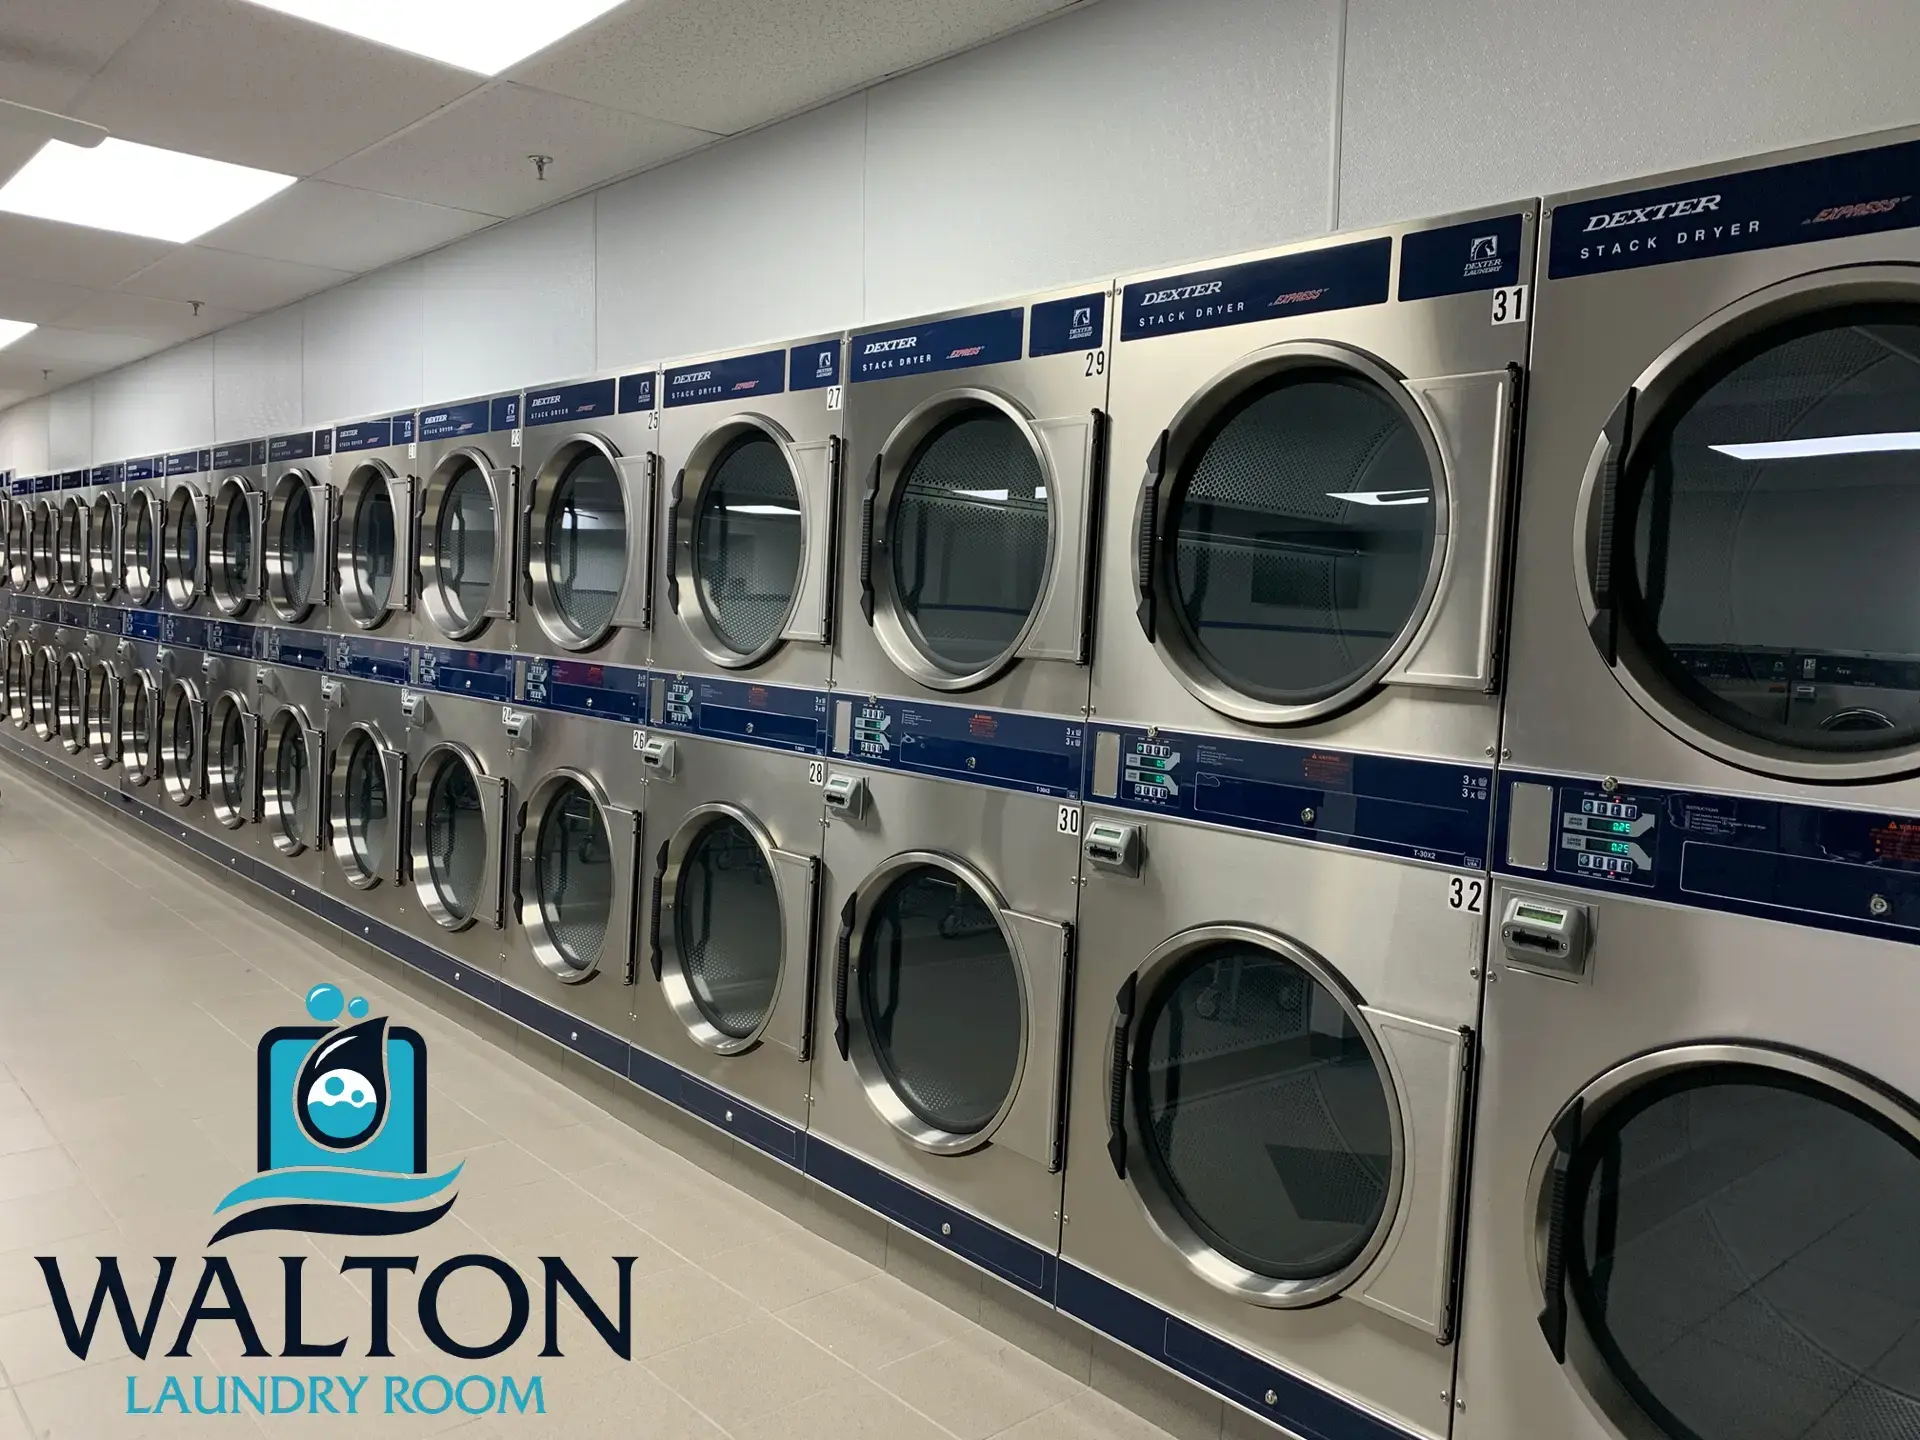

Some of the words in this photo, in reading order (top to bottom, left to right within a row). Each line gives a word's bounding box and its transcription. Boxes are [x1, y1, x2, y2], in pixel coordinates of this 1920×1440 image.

[1583, 194, 1722, 232] DEXTER
[1580, 237, 1657, 260] STACK
[1677, 220, 1761, 244] DRYER
[1463, 265, 1502, 277] LAUNDRY
[1464, 258, 1502, 272] DEXTER
[1140, 280, 1222, 306] DEXTER
[1138, 311, 1186, 328] STACK
[1196, 302, 1245, 318] DRYER
[1493, 288, 1524, 323] 31
[864, 336, 917, 355] DEXTER
[862, 360, 894, 372] STACK
[900, 354, 932, 367] DRYER
[1084, 350, 1105, 378] 29
[672, 370, 712, 385] DEXTER
[532, 395, 561, 408] DEXTER
[672, 390, 694, 400] STACK
[698, 386, 722, 396] DRYER
[828, 388, 841, 409] 27
[648, 412, 658, 430] 25
[634, 731, 644, 750] 26
[810, 762, 822, 783] 28
[1059, 807, 1078, 833] 30
[1450, 878, 1482, 913] 32
